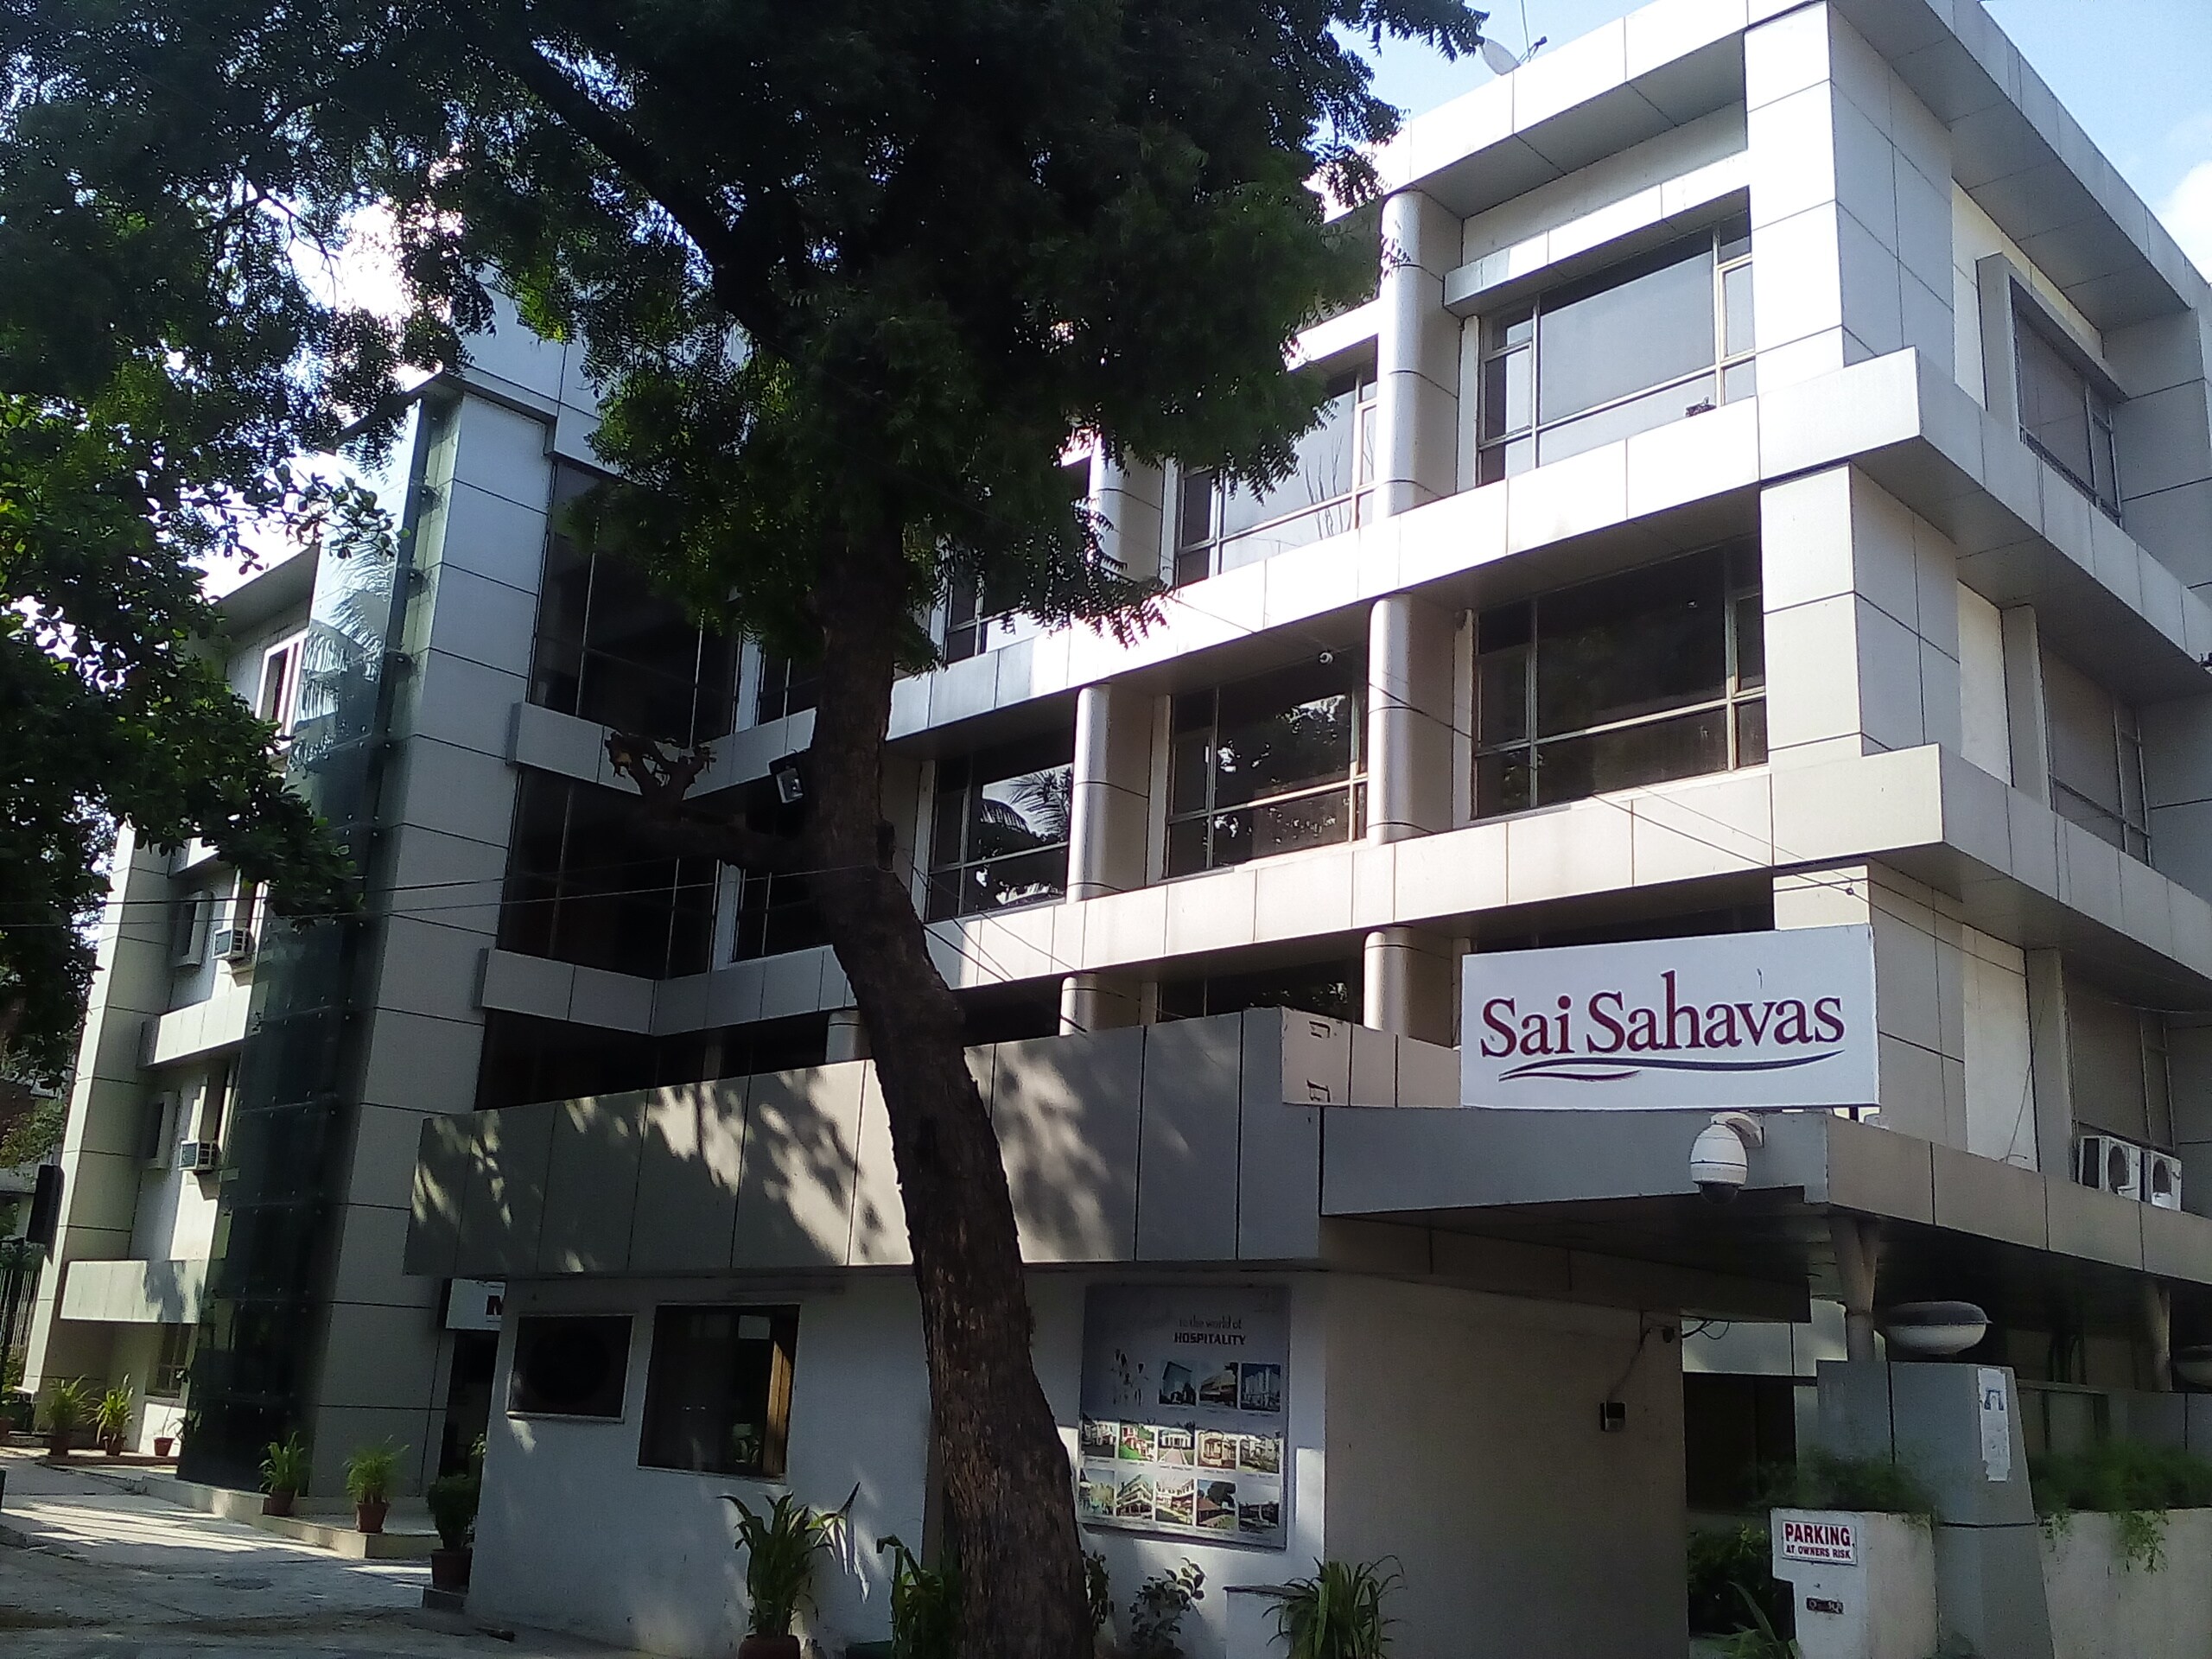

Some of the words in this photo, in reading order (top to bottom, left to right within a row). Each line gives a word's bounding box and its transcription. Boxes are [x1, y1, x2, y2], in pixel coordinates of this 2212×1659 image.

[1480, 995, 1575, 1058] Sai
[1586, 969, 1846, 1054] Sahavas
[1190, 1314, 1204, 1328] the
[1205, 1315, 1231, 1329] world
[1232, 1318, 1243, 1330] of
[1174, 1332, 1246, 1345] HOSPITALITY
[1784, 1523, 1851, 1547] PARKING
[1797, 1546, 1830, 1557] OWNERS
[1833, 1549, 1851, 1559] RISK
